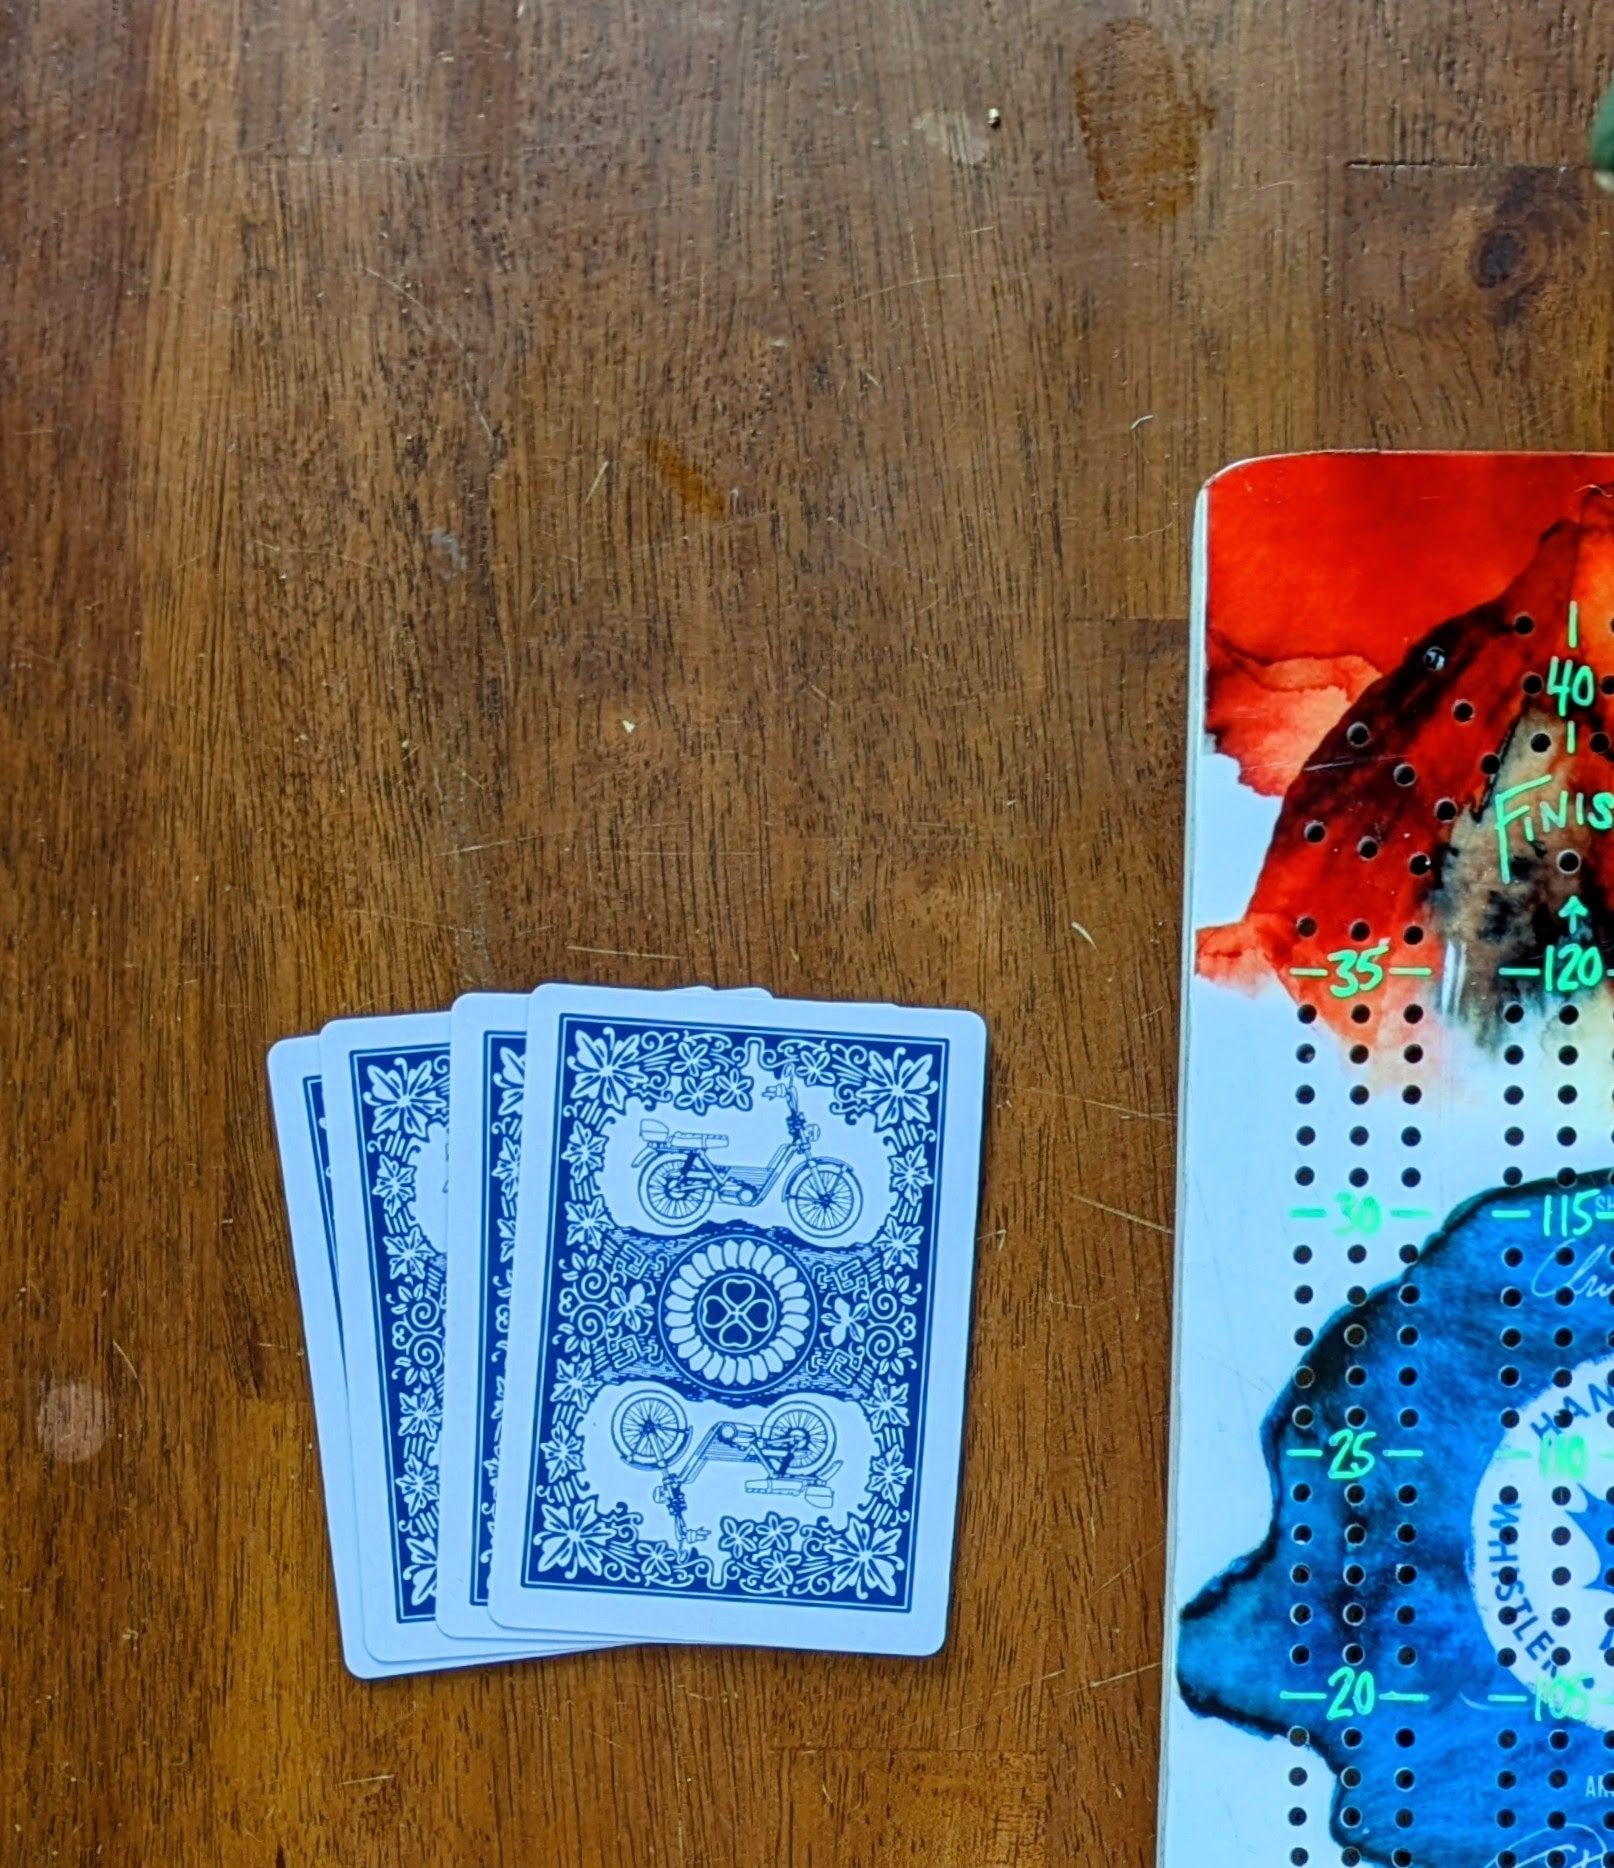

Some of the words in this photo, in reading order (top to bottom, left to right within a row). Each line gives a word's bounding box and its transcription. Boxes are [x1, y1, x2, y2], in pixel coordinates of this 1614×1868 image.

[1546, 655, 1596, 717] 40
[1327, 938, 1391, 998] 35
[1544, 945, 1604, 994] 120
[1332, 1191, 1383, 1239] 30
[1542, 1188, 1601, 1238] 115
[1328, 1431, 1378, 1480] 25
[1538, 1431, 1589, 1479] 110
[1328, 1666, 1376, 1720] 20
